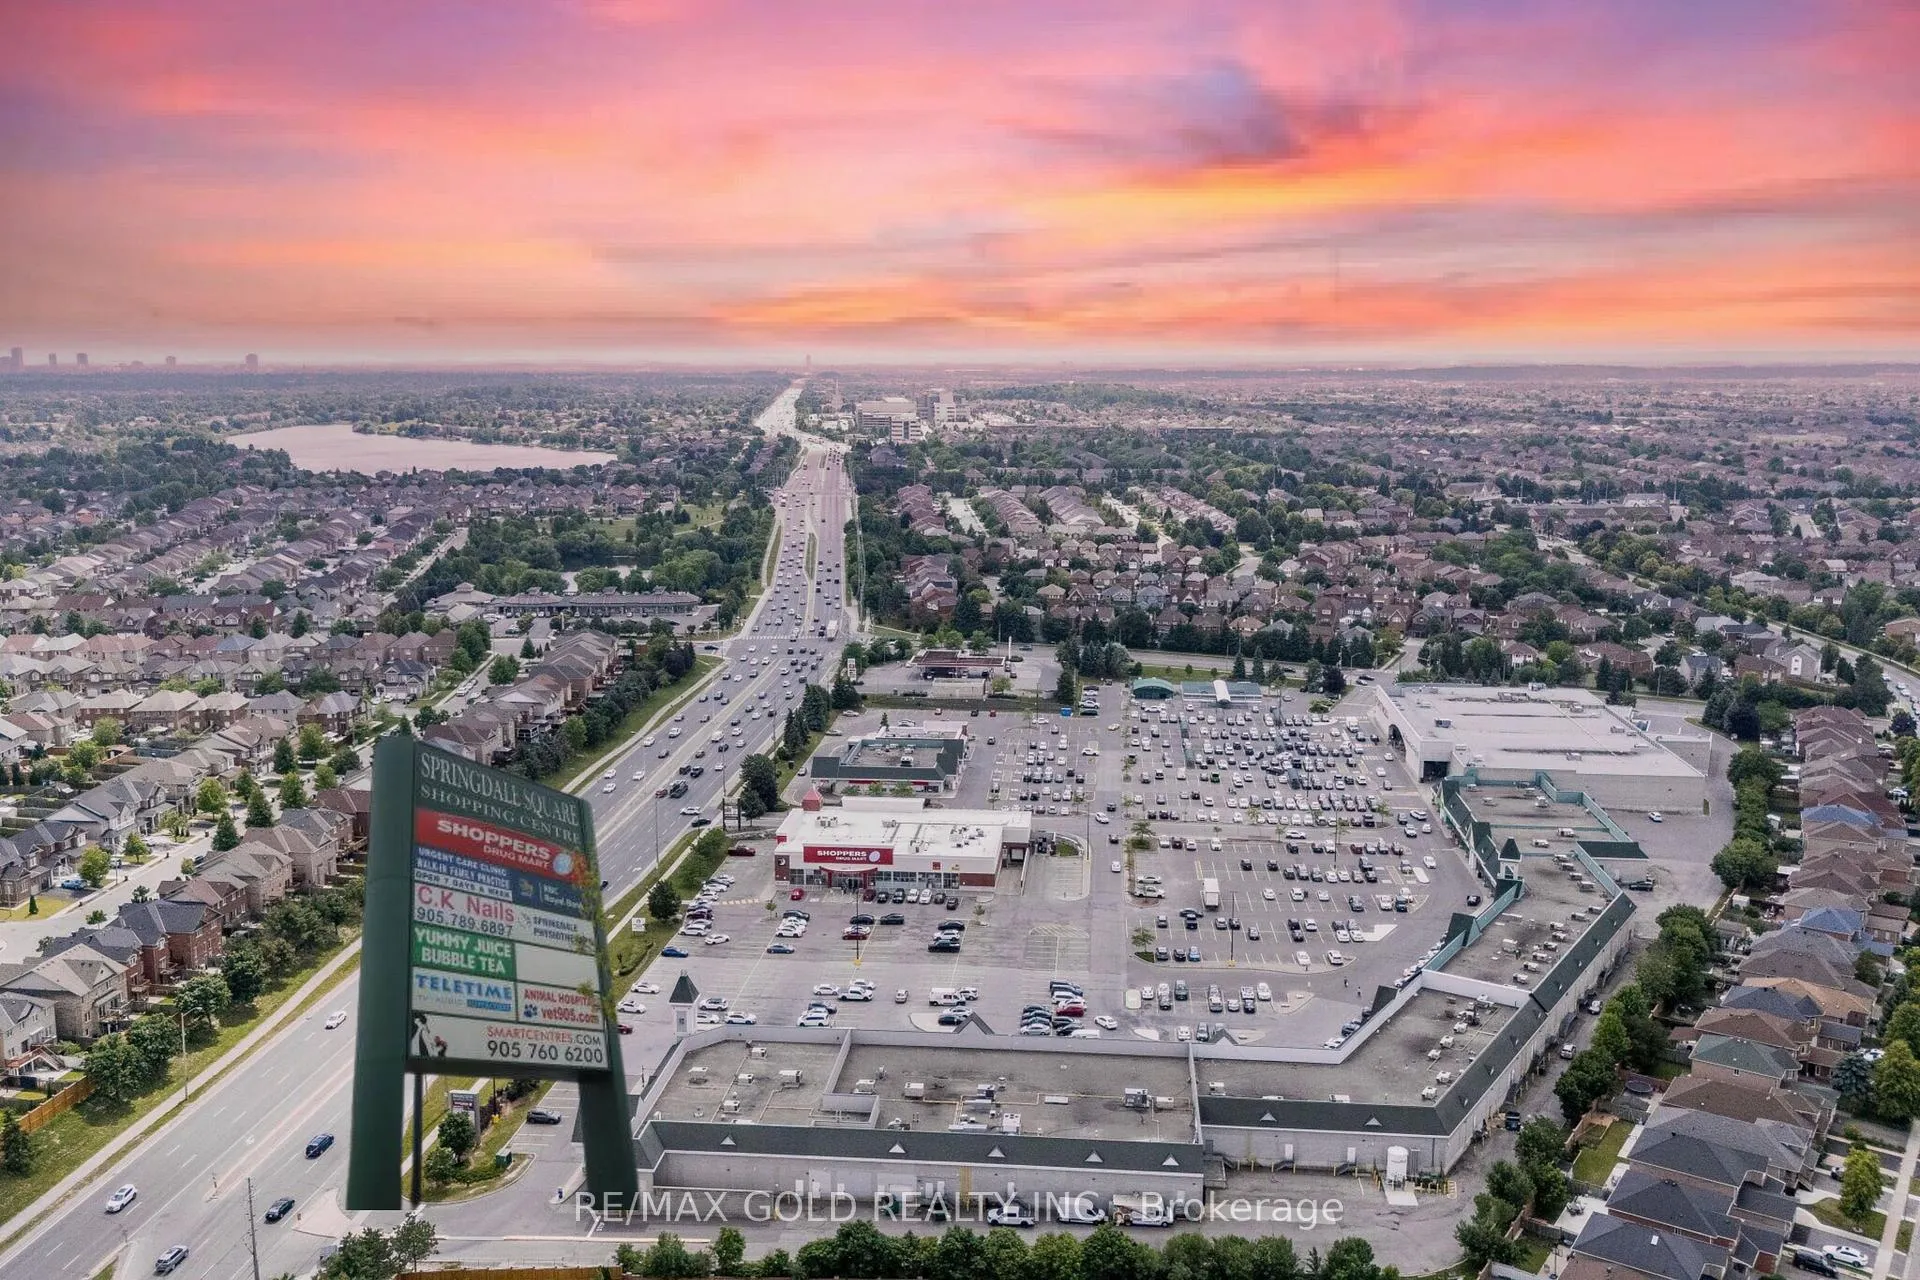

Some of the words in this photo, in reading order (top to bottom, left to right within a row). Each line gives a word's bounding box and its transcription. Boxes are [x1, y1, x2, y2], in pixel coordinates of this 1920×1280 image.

[421, 752, 521, 807] SPRINGDALE
[524, 789, 579, 827] SQUARE
[421, 784, 514, 823] SHOPPING
[520, 815, 582, 845] CENTRE
[437, 819, 551, 861] SHOPPERS
[418, 847, 454, 862] URGENT
[456, 857, 479, 870] CARE
[483, 845, 515, 861] DRUG
[518, 854, 550, 871] MART
[415, 870, 440, 882] OPEN
[452, 879, 475, 890] DAYS
[466, 895, 515, 922] Nails
[414, 927, 469, 951] YUMMY
[474, 938, 511, 958] JUICE
[421, 949, 476, 970] BUBBLE
[479, 958, 506, 974] TEA
[415, 974, 512, 1000] TELETIME
[524, 988, 557, 1003] ANIMAL
[487, 1026, 600, 1045] SMARTCENTRES.COM
[487, 1040, 521, 1058] 905
[528, 1043, 559, 1060] 760
[565, 1047, 603, 1063] 6200
